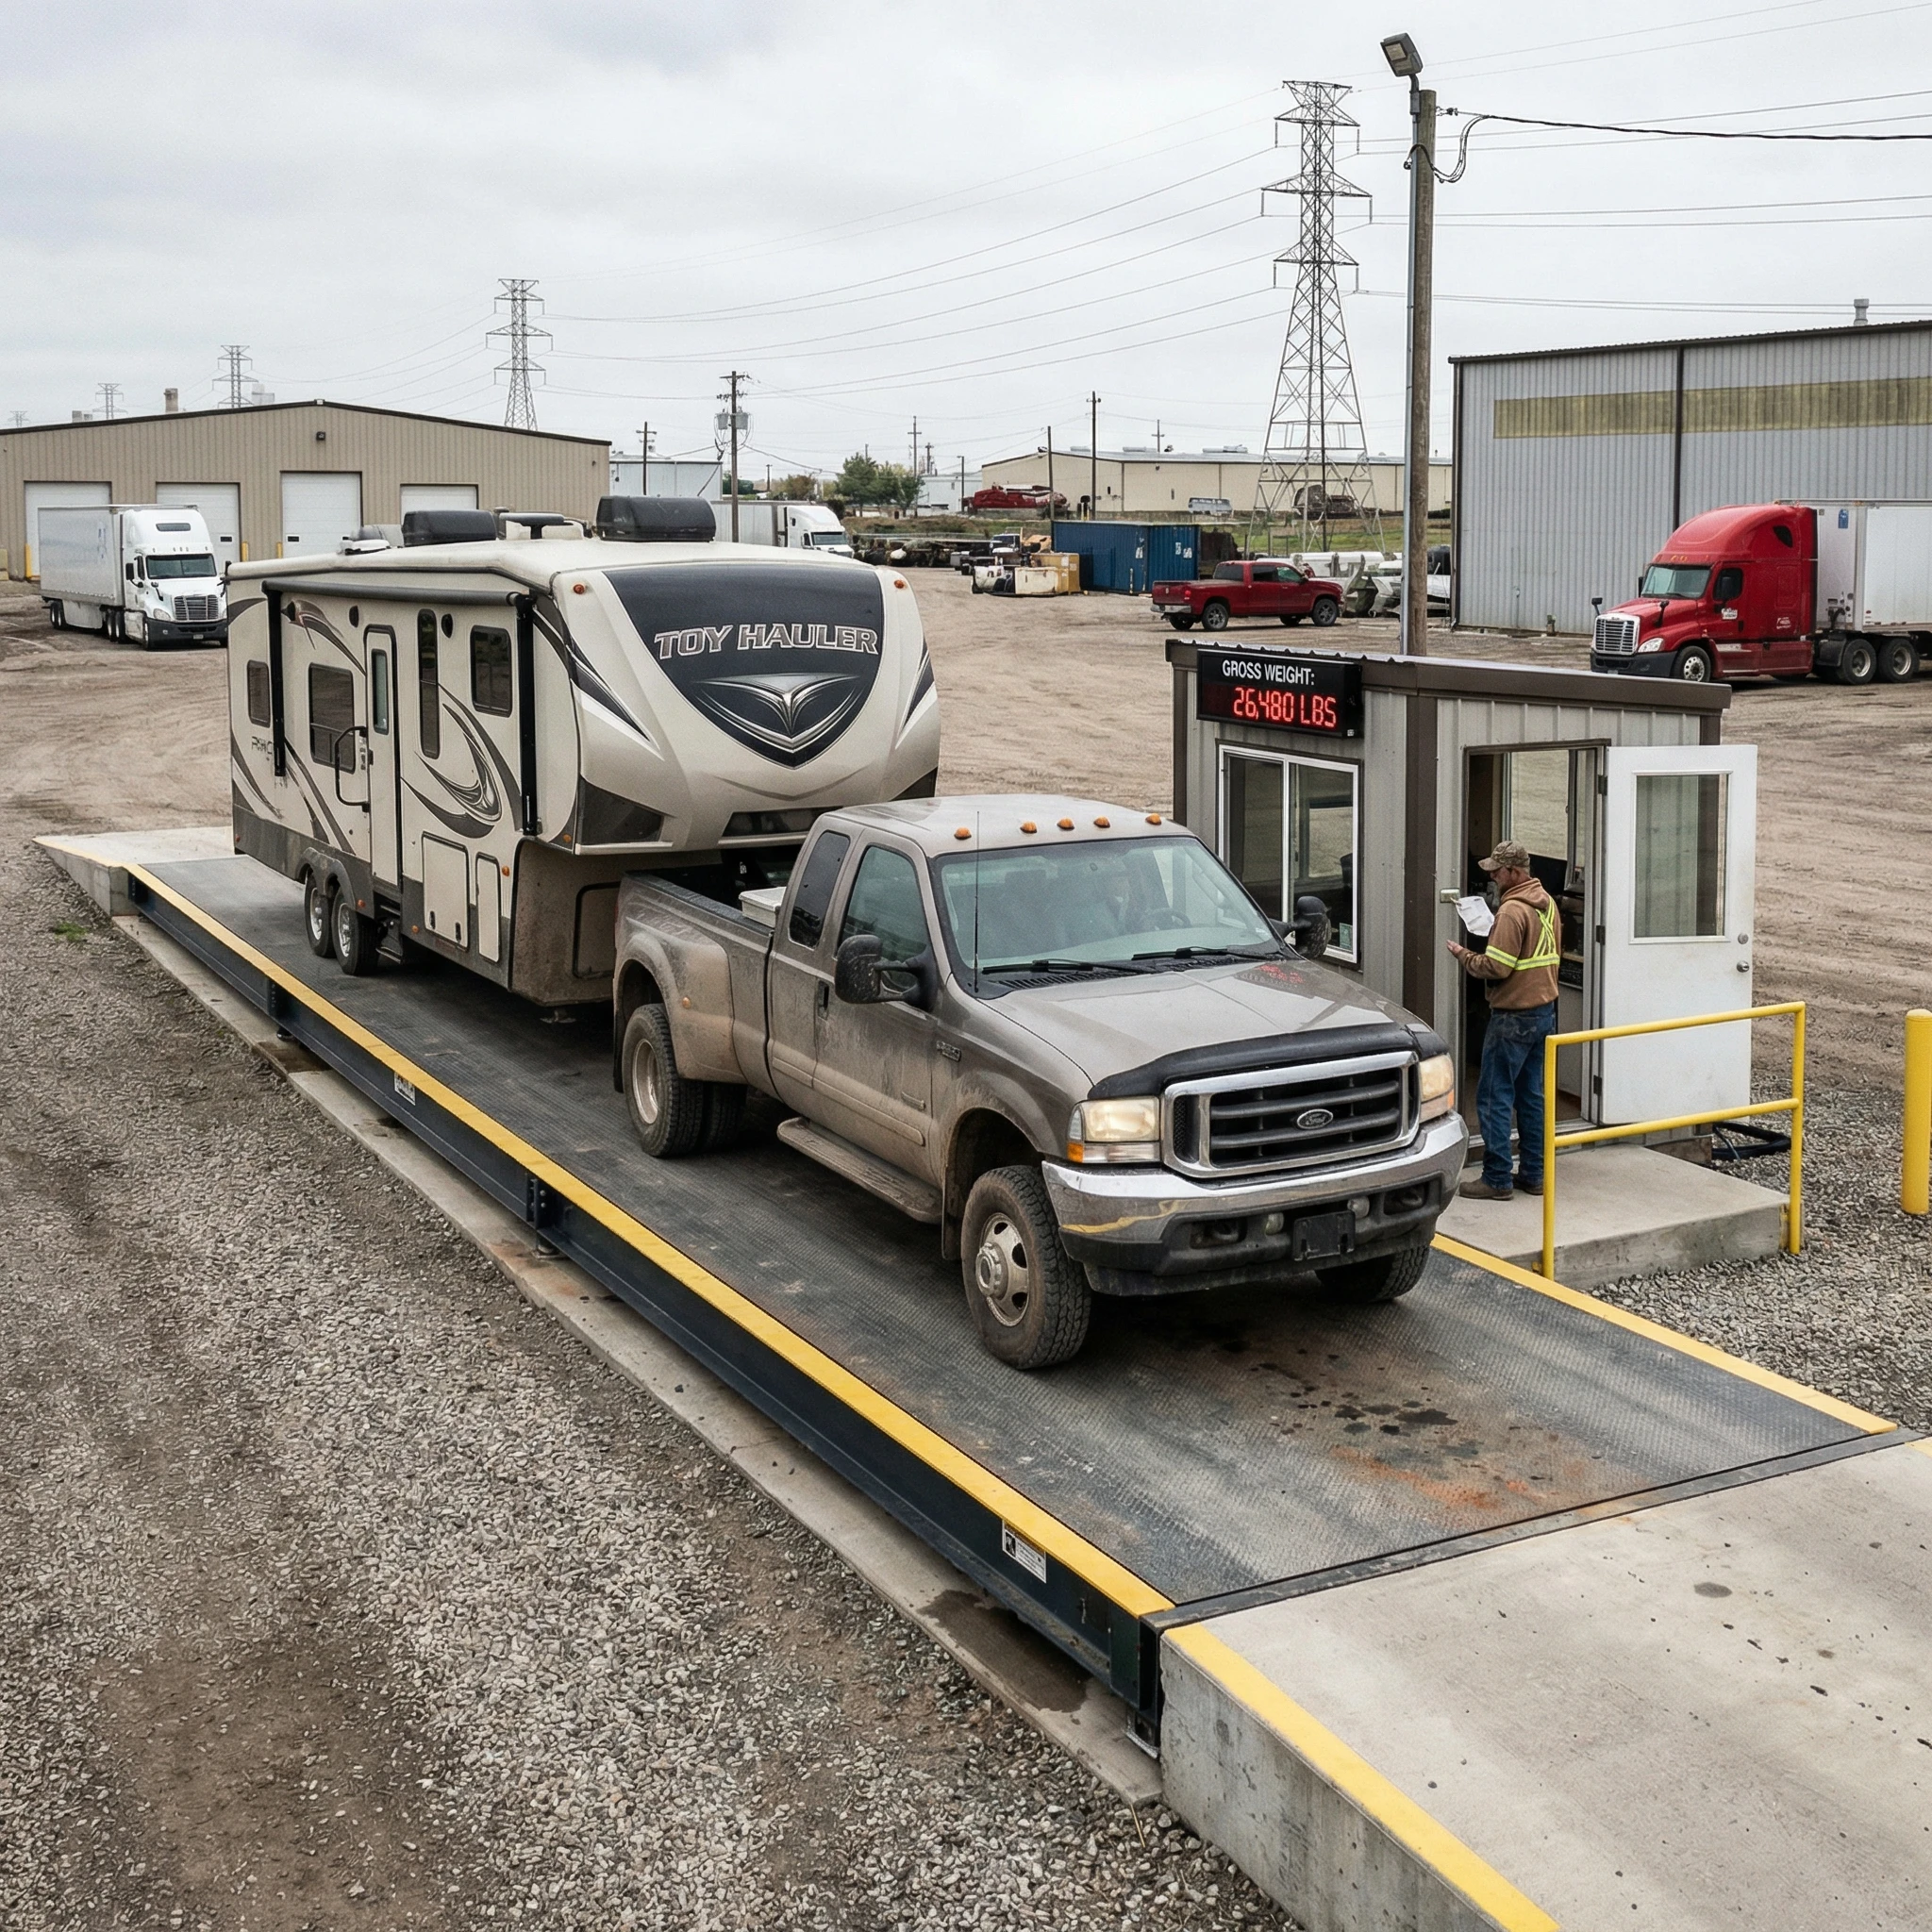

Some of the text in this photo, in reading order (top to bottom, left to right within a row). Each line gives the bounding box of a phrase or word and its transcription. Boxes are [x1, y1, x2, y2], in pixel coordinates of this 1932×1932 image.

[654, 623, 879, 659] TOY HAULER
[1222, 659, 1315, 686] GROSS WEIGHT:
[1233, 687, 1337, 727] 26,480 LBS
